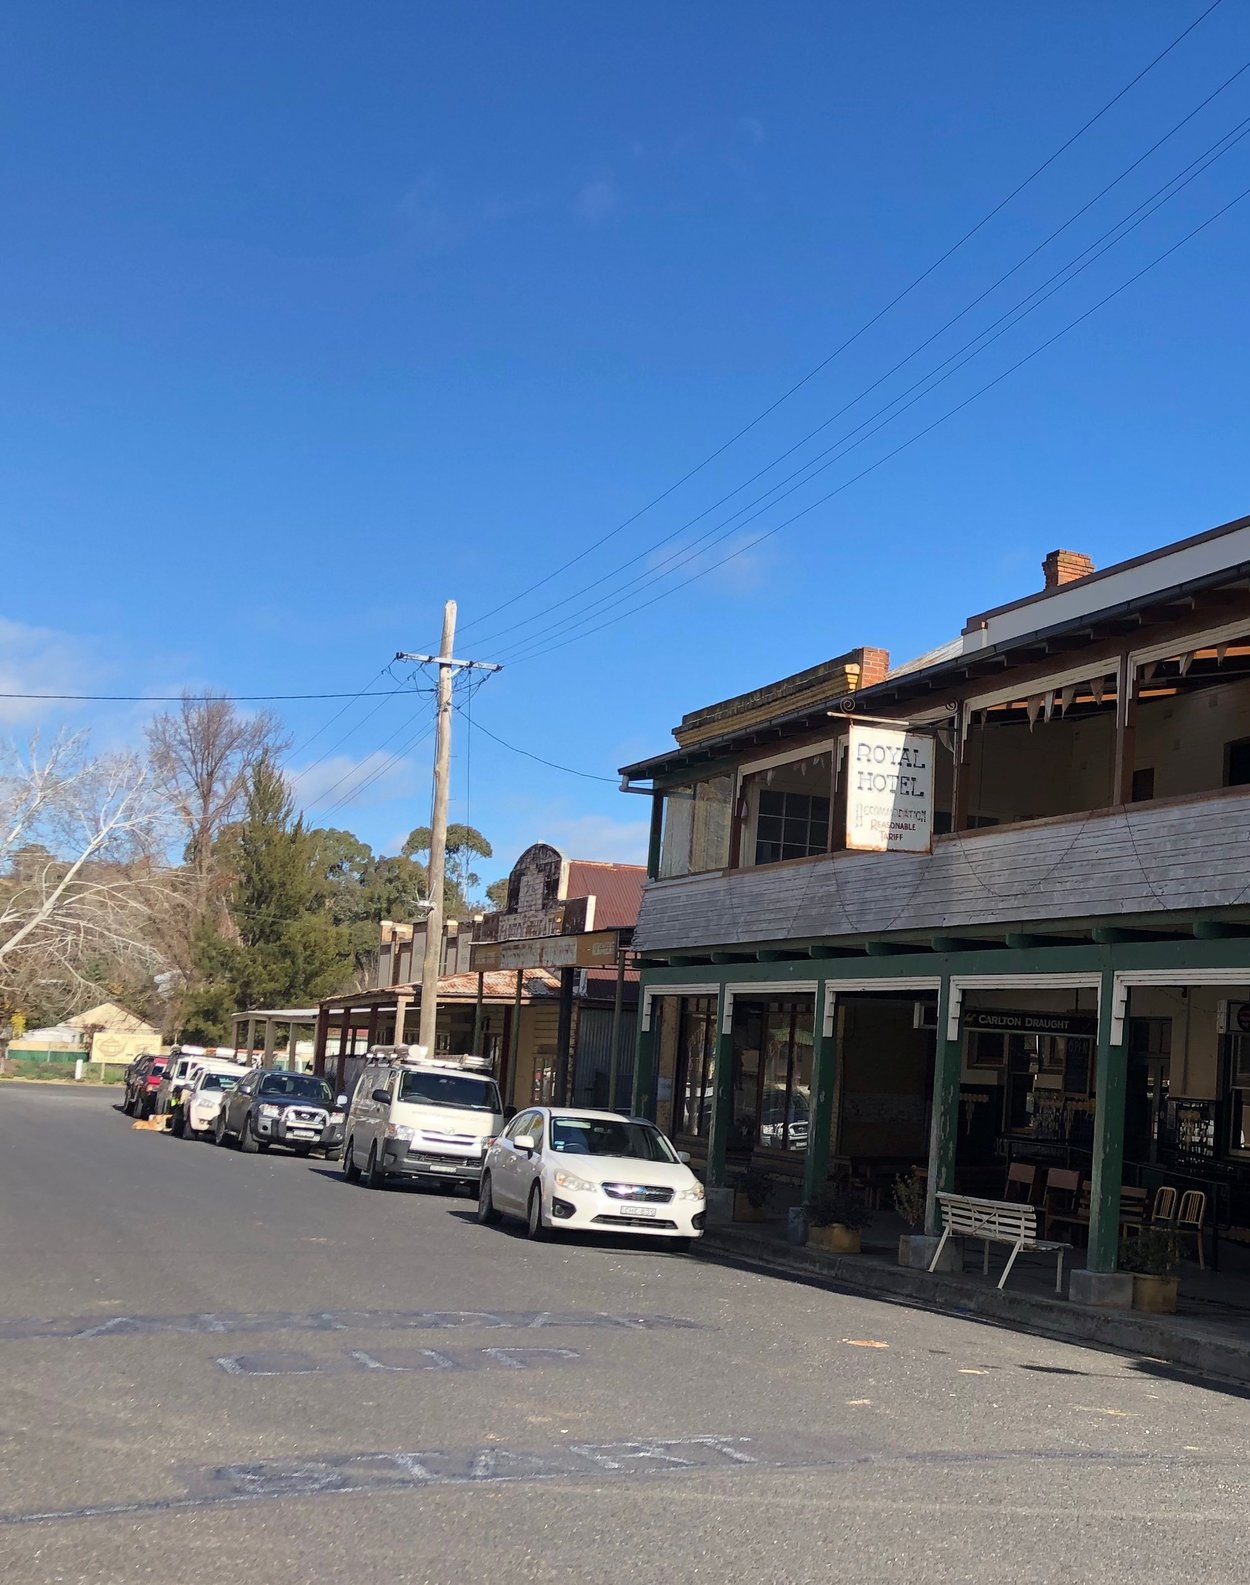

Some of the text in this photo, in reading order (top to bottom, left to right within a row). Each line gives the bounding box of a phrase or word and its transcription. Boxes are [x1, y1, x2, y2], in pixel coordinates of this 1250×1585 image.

[857, 743, 926, 769] ROYAL
[857, 771, 925, 797] HOTEL
[978, 1014, 1070, 1030] CARLTON DRAUGHT
